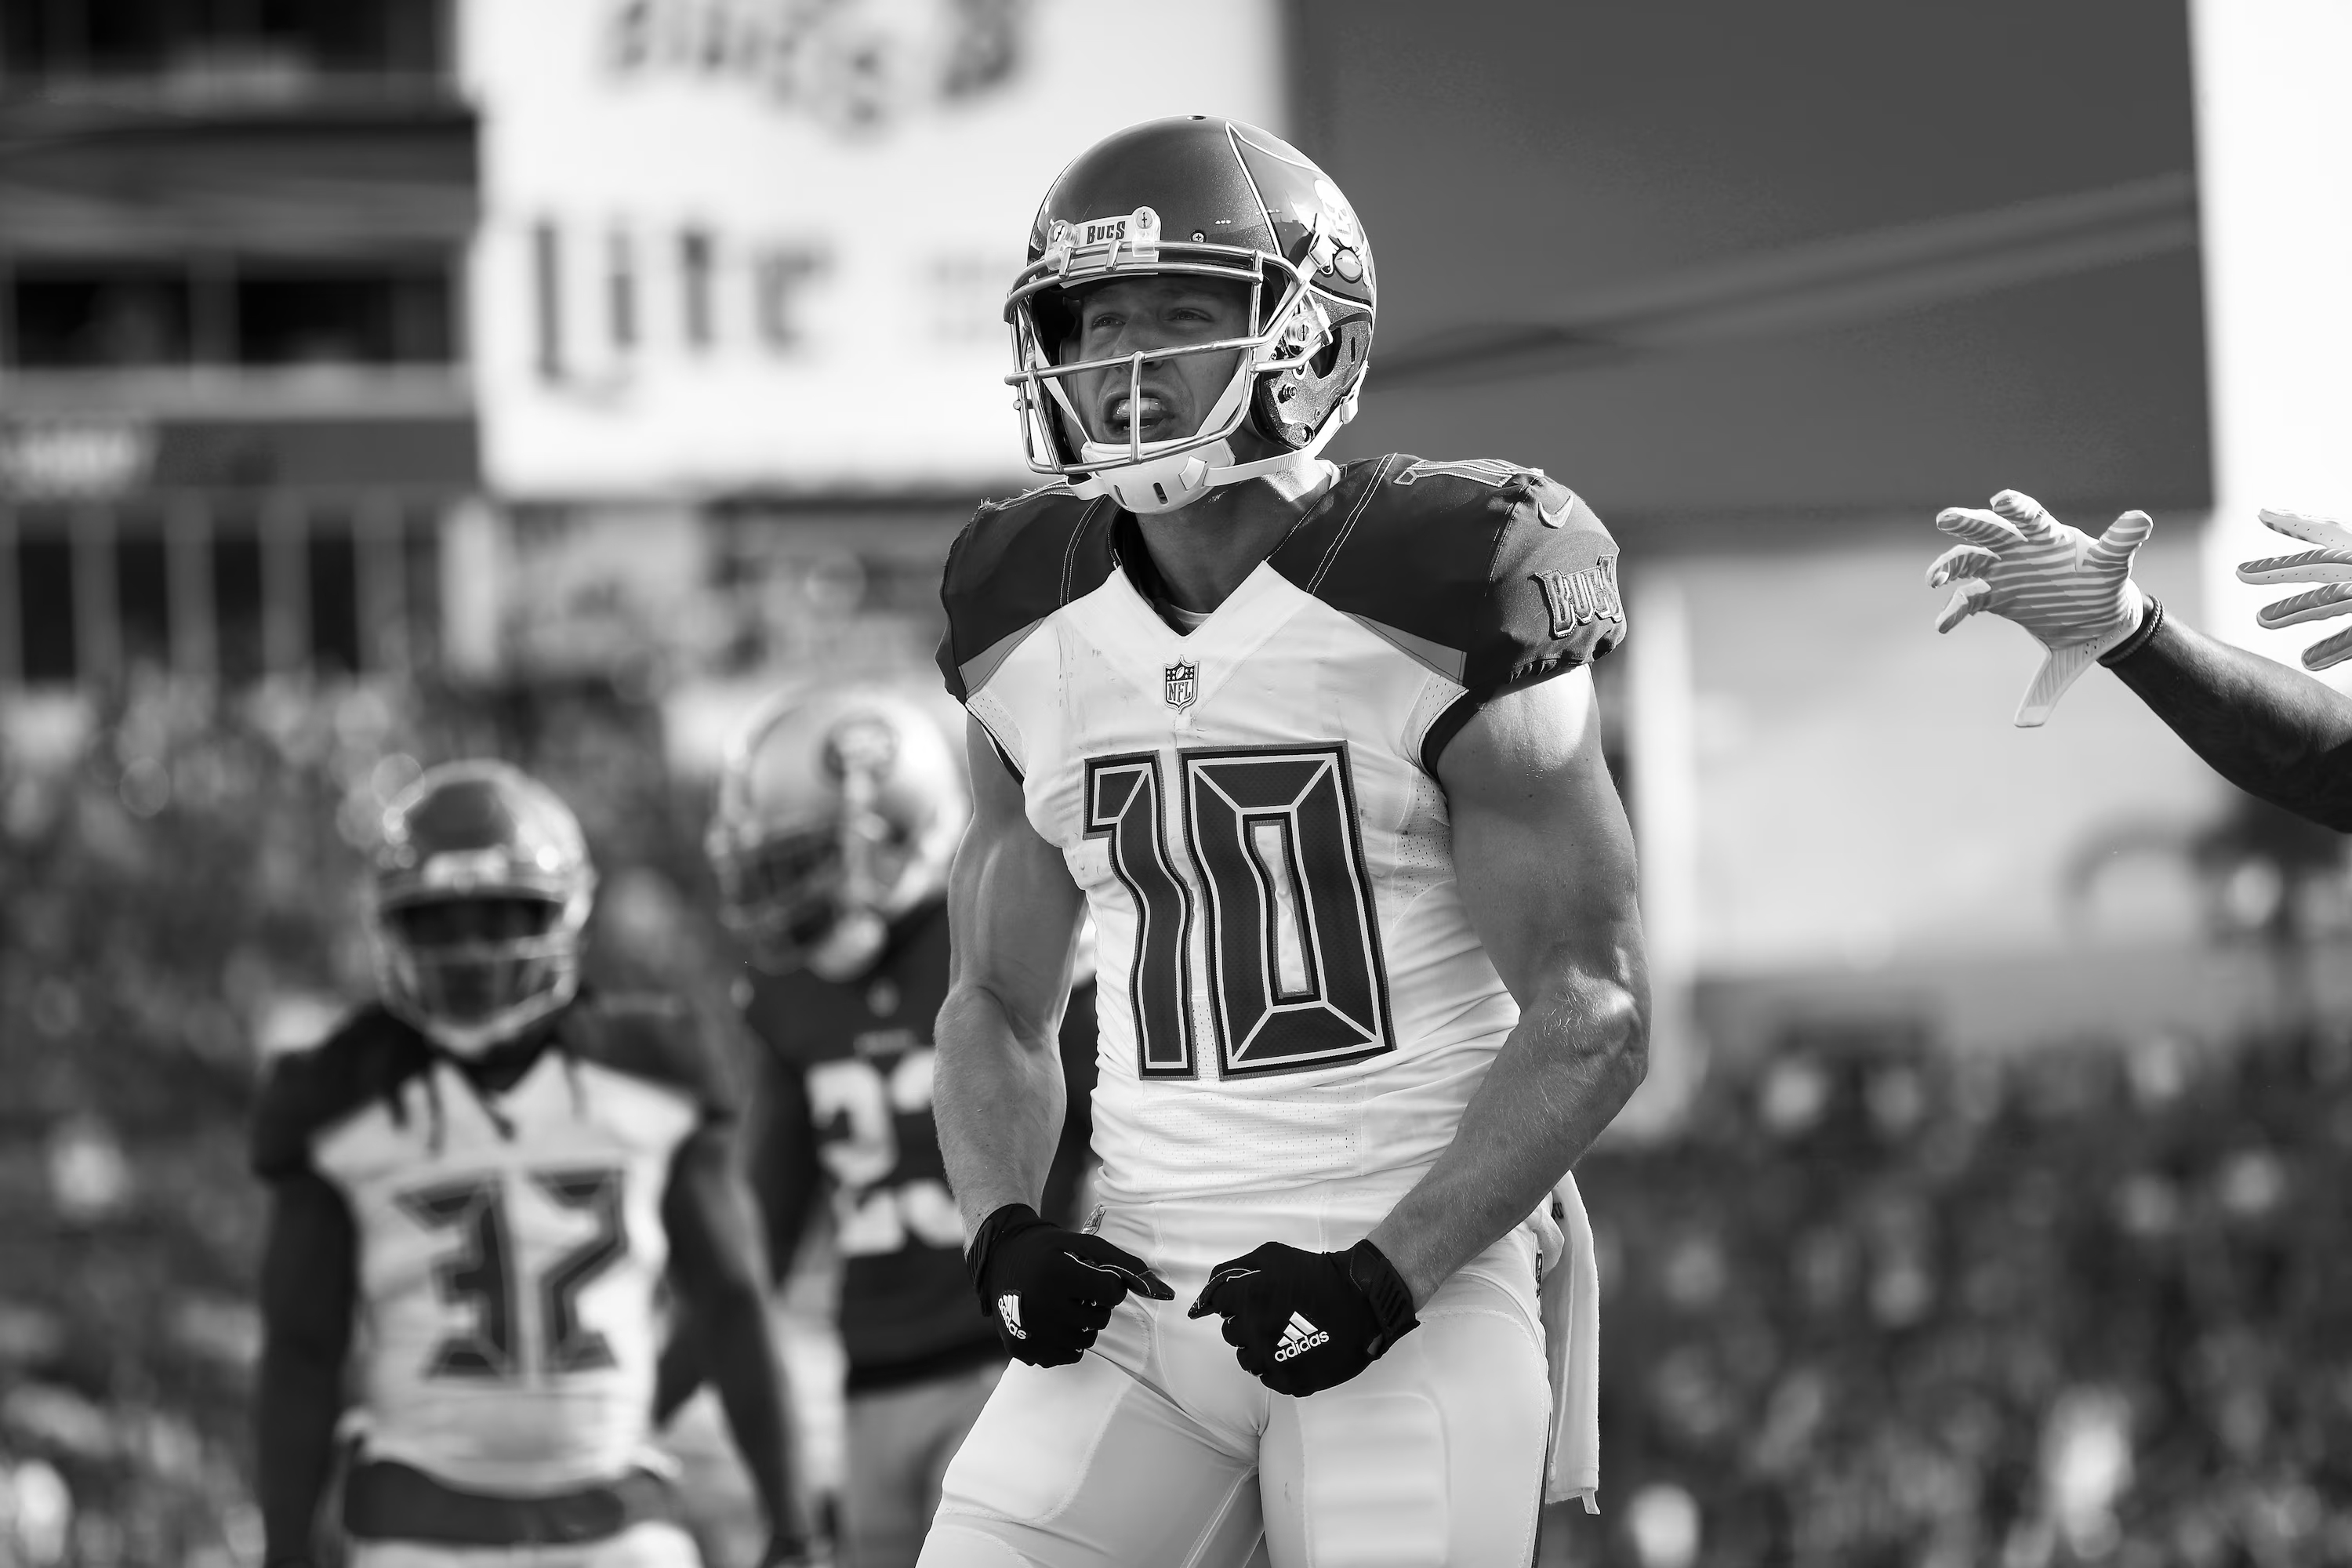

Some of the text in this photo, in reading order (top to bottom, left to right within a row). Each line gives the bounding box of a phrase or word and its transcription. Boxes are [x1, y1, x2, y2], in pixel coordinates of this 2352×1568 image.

[1087, 221, 1126, 245] BUCS
[1168, 681, 1191, 702] NFL
[1083, 739, 1397, 1081] 10
[393, 1167, 629, 1381] 32
[998, 1298, 1027, 1339] adidas
[1274, 1330, 1330, 1362] adidas
